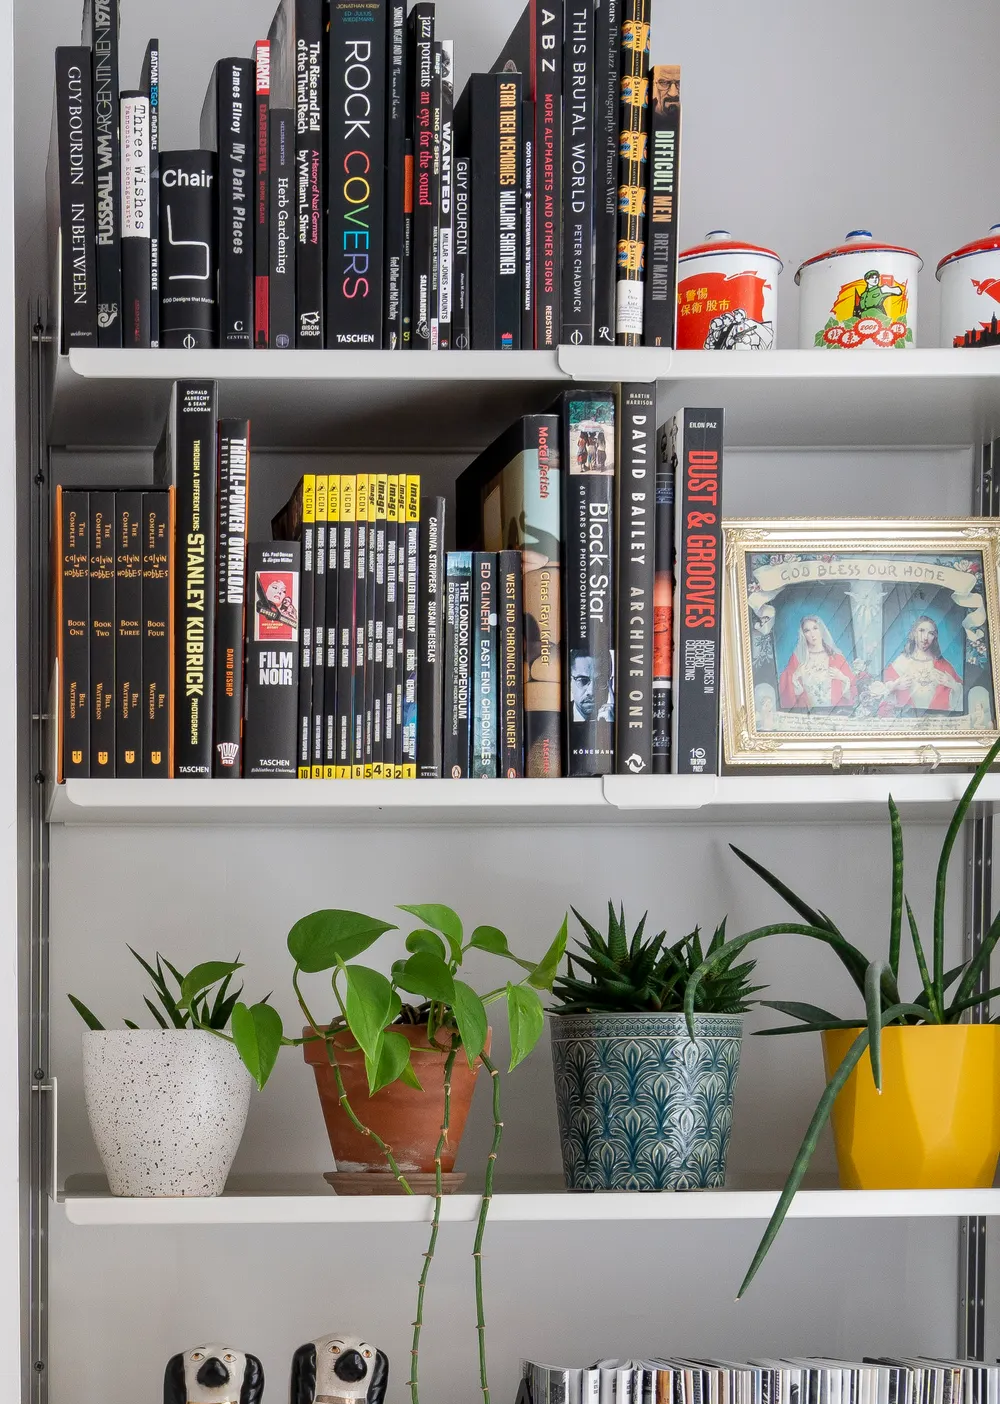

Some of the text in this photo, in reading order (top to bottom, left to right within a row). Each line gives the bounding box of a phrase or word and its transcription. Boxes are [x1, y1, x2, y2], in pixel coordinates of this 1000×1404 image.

[230, 65, 242, 134] James Ellroy
[256, 46, 270, 92] MARVEL
[297, 39, 308, 134] of the Third Reich
[309, 41, 320, 131] The Rise and Fall
[416, 14, 435, 205] jazz portraits an eye for the sound
[571, 8, 587, 213] THIS BRUTAL WORLD
[67, 66, 84, 185] GUY BOURDIN
[133, 104, 147, 230] Three Wishes
[161, 168, 213, 188] Chair
[342, 40, 371, 299] ROCK COVERS
[442, 121, 451, 214] WANTED
[499, 83, 516, 275] STAR TREK MEMORIES WILLIAM SHATNER
[71, 203, 87, 304] IN BETWEEN
[229, 142, 246, 254] My Dark Places
[276, 177, 288, 274] Herb Gardening
[651, 130, 675, 301] DIFFICULT MEN BRETT MARTIN
[573, 224, 582, 313] PETER CHADWICK
[226, 438, 247, 604] THRILL-POWER OVERLOAD
[588, 502, 609, 623] Black Star
[628, 414, 647, 729] DAVID BAILEY ARCHIVE ONE
[684, 450, 718, 628] DUST & GROOVES
[780, 564, 945, 582] GOD BLESS OUR HOME
[185, 533, 205, 745] STANLEY KUBRICK PHOTOGRAPHS
[225, 648, 235, 697] DAVID BISHOP
[258, 651, 293, 669] FILM
[258, 668, 293, 685] NOIR
[505, 572, 517, 749] WEST END CHRONICLES ED GLINERT
